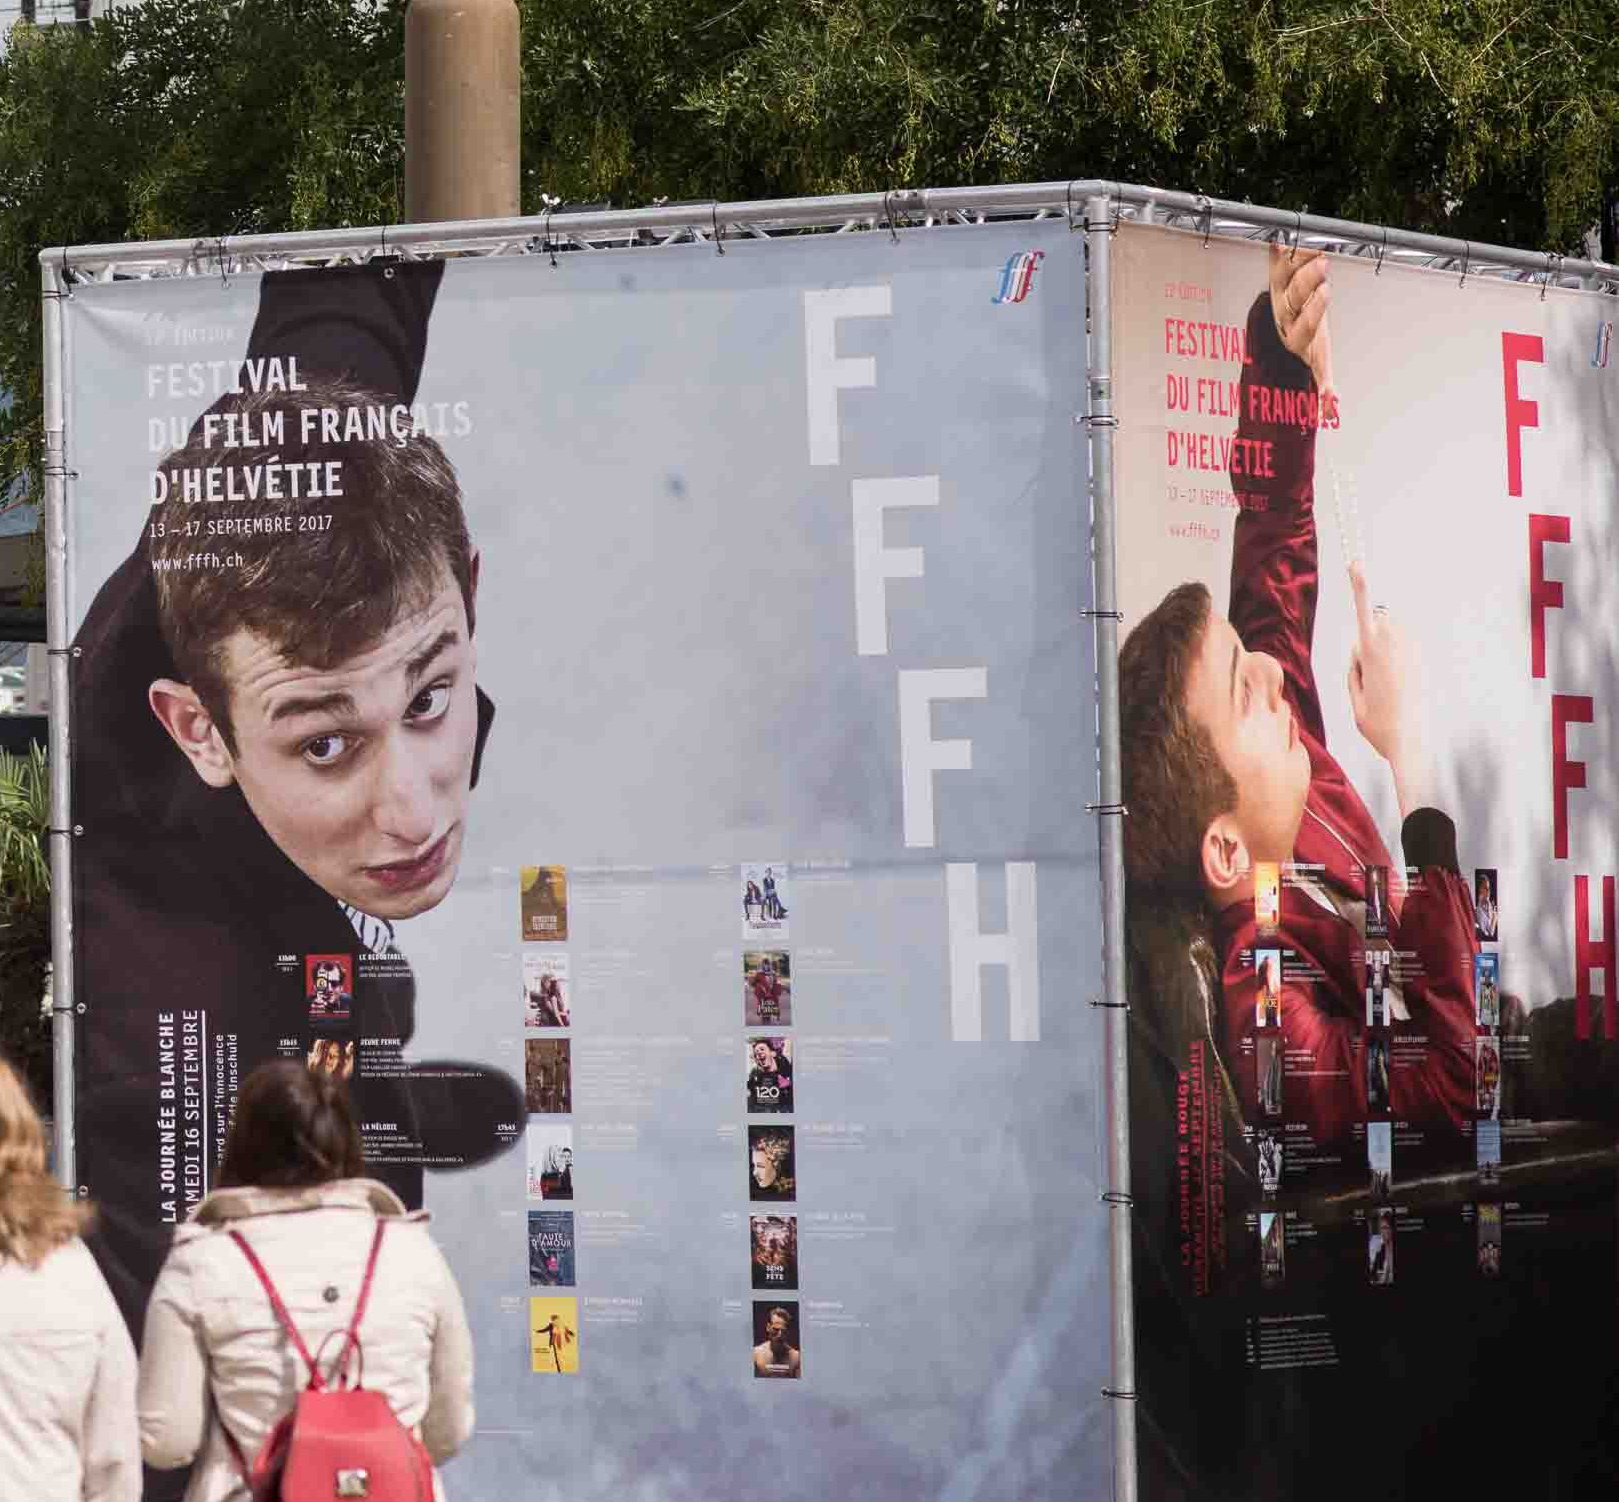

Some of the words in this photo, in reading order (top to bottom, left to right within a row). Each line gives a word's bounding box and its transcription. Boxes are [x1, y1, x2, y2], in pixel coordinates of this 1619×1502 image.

[1165, 319, 1253, 365] FESTIVAL
[148, 356, 308, 398] FESTIVAL
[149, 417, 189, 451] DU
[204, 411, 284, 449] FILM
[300, 401, 472, 448] FRANÇAIS
[1166, 374, 1189, 411] DU
[1197, 378, 1241, 417] FILM
[1248, 384, 1340, 432] FRANÇAIS
[1167, 428, 1276, 477] D'HELVÉTIE
[150, 455, 344, 505] D'HELVÉTIE
[149, 523, 166, 538] 13
[186, 522, 200, 537] 17
[208, 516, 292, 536] SEPTEMBRE
[299, 515, 333, 532] 2017
[152, 552, 243, 571] www.fffh.ch
[159, 1012, 176, 1099] BLANCHE
[183, 1010, 200, 1121] SEPTEMBRE
[214, 1034, 225, 1108] l'innocence
[756, 1086, 780, 1098] 120
[185, 1128, 200, 1148] 16
[215, 1113, 225, 1134] sur
[157, 1106, 176, 1194] JOURNÉE
[162, 1200, 177, 1223] LA
[185, 1155, 201, 1222] AMEDI
